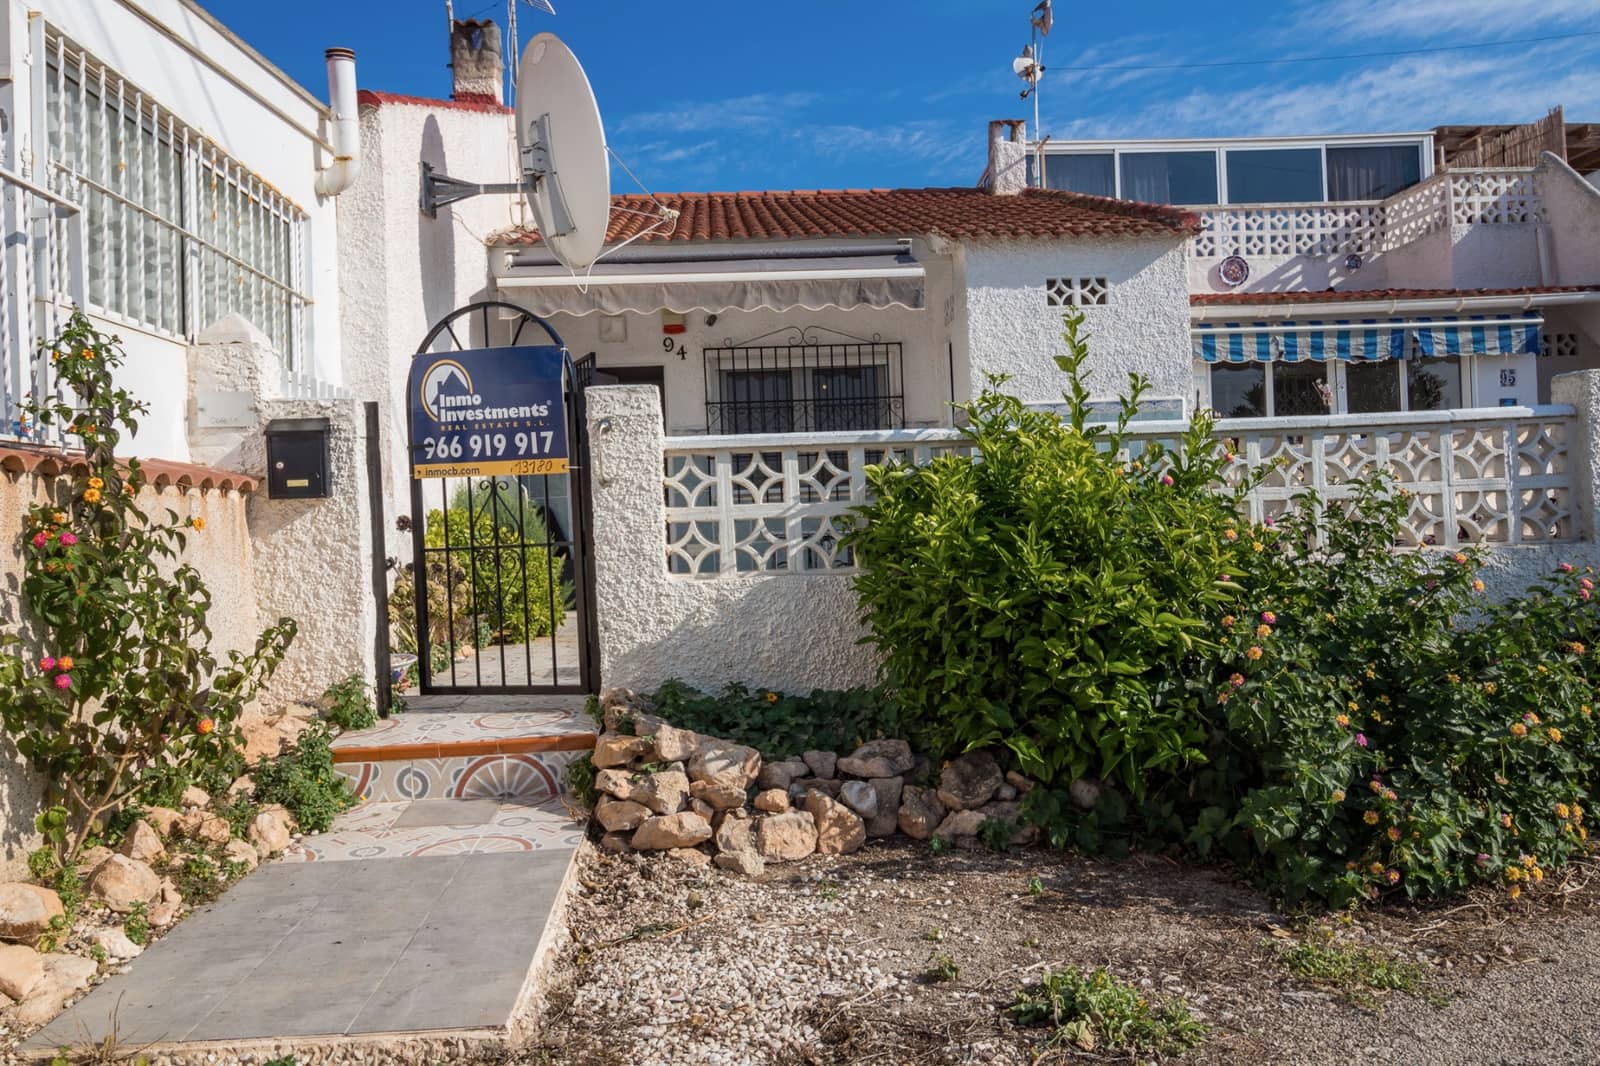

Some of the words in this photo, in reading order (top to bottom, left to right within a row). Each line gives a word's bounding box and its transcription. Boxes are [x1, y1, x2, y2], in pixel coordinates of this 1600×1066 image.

[663, 336, 688, 361] 94
[439, 393, 482, 408] Inmo
[439, 403, 549, 423] Investments
[440, 424, 468, 432] REAL
[474, 421, 519, 430] ESTATE
[423, 435, 463, 460] 966
[469, 433, 507, 457] 919
[514, 431, 555, 456] 917
[425, 466, 481, 477] inmocb.com
